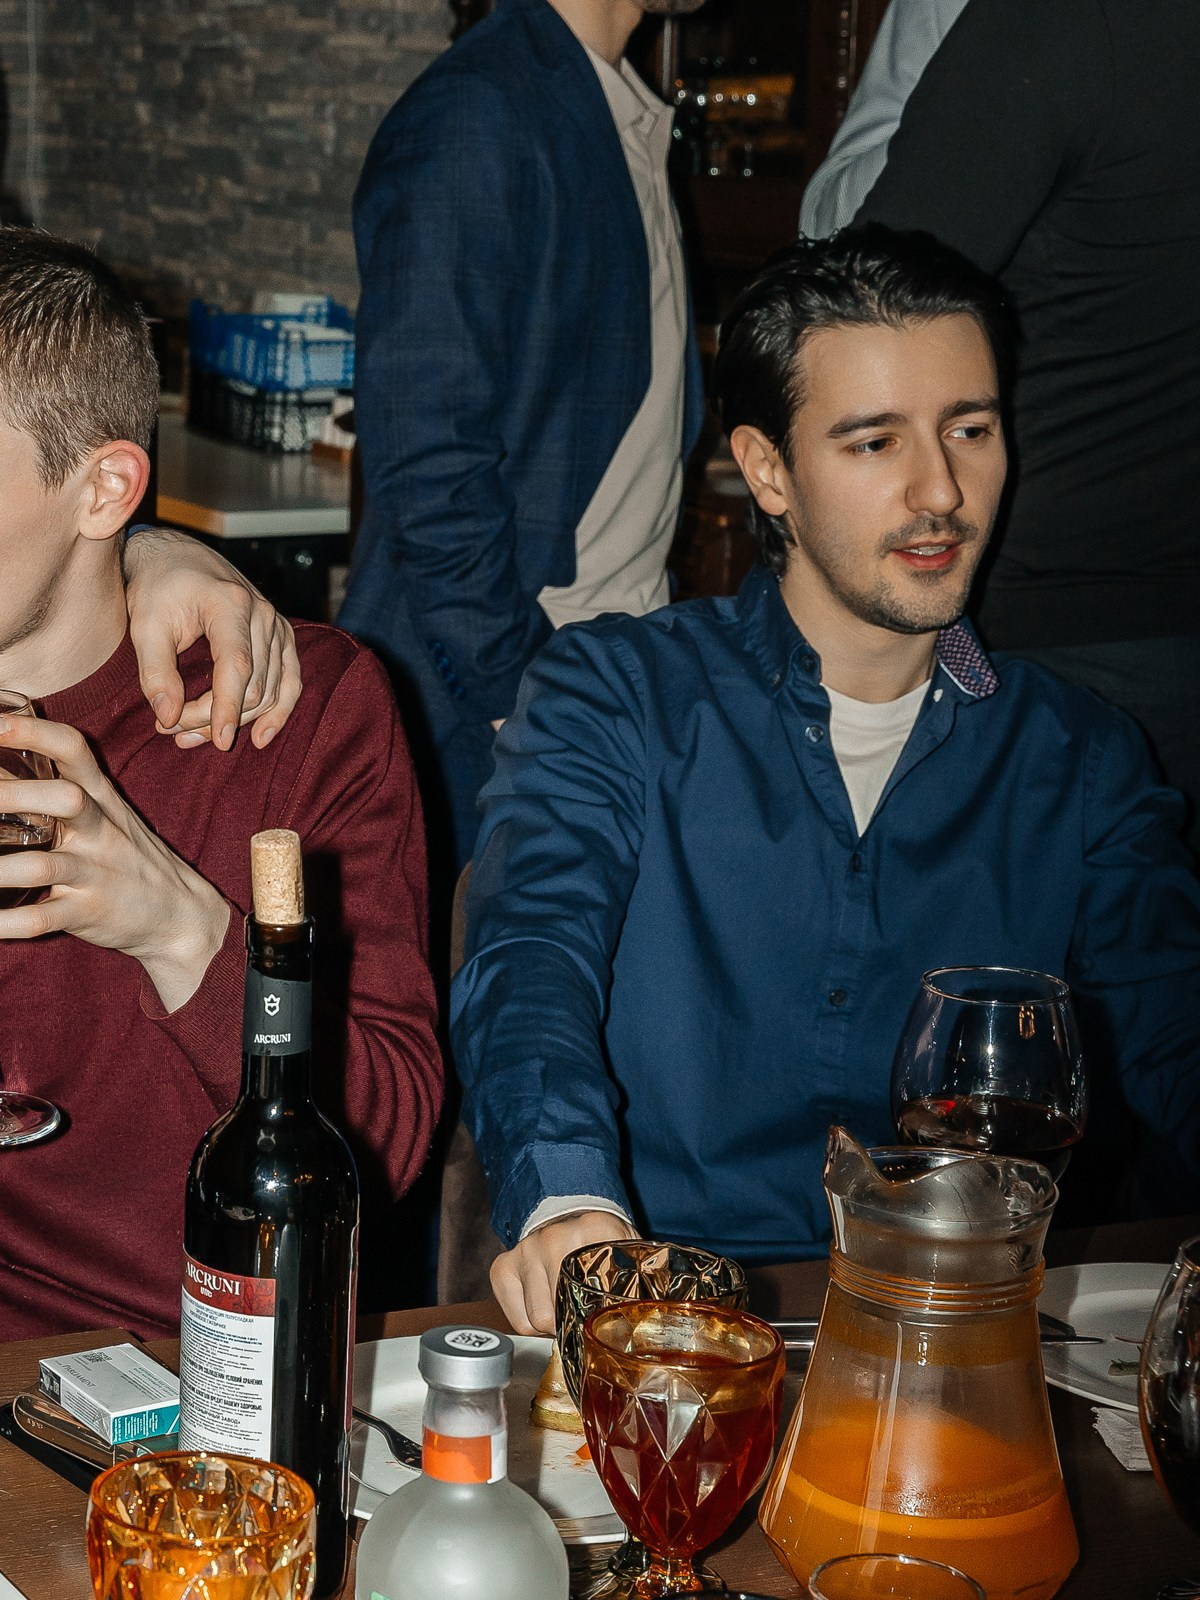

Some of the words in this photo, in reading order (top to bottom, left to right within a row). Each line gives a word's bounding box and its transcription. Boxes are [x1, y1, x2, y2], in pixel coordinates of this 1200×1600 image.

[254, 1033, 291, 1044] ARCRUNI
[185, 1261, 241, 1295] ARCRUNI
[224, 1314, 254, 1323] ПОЛУСЛАДКАЯ
